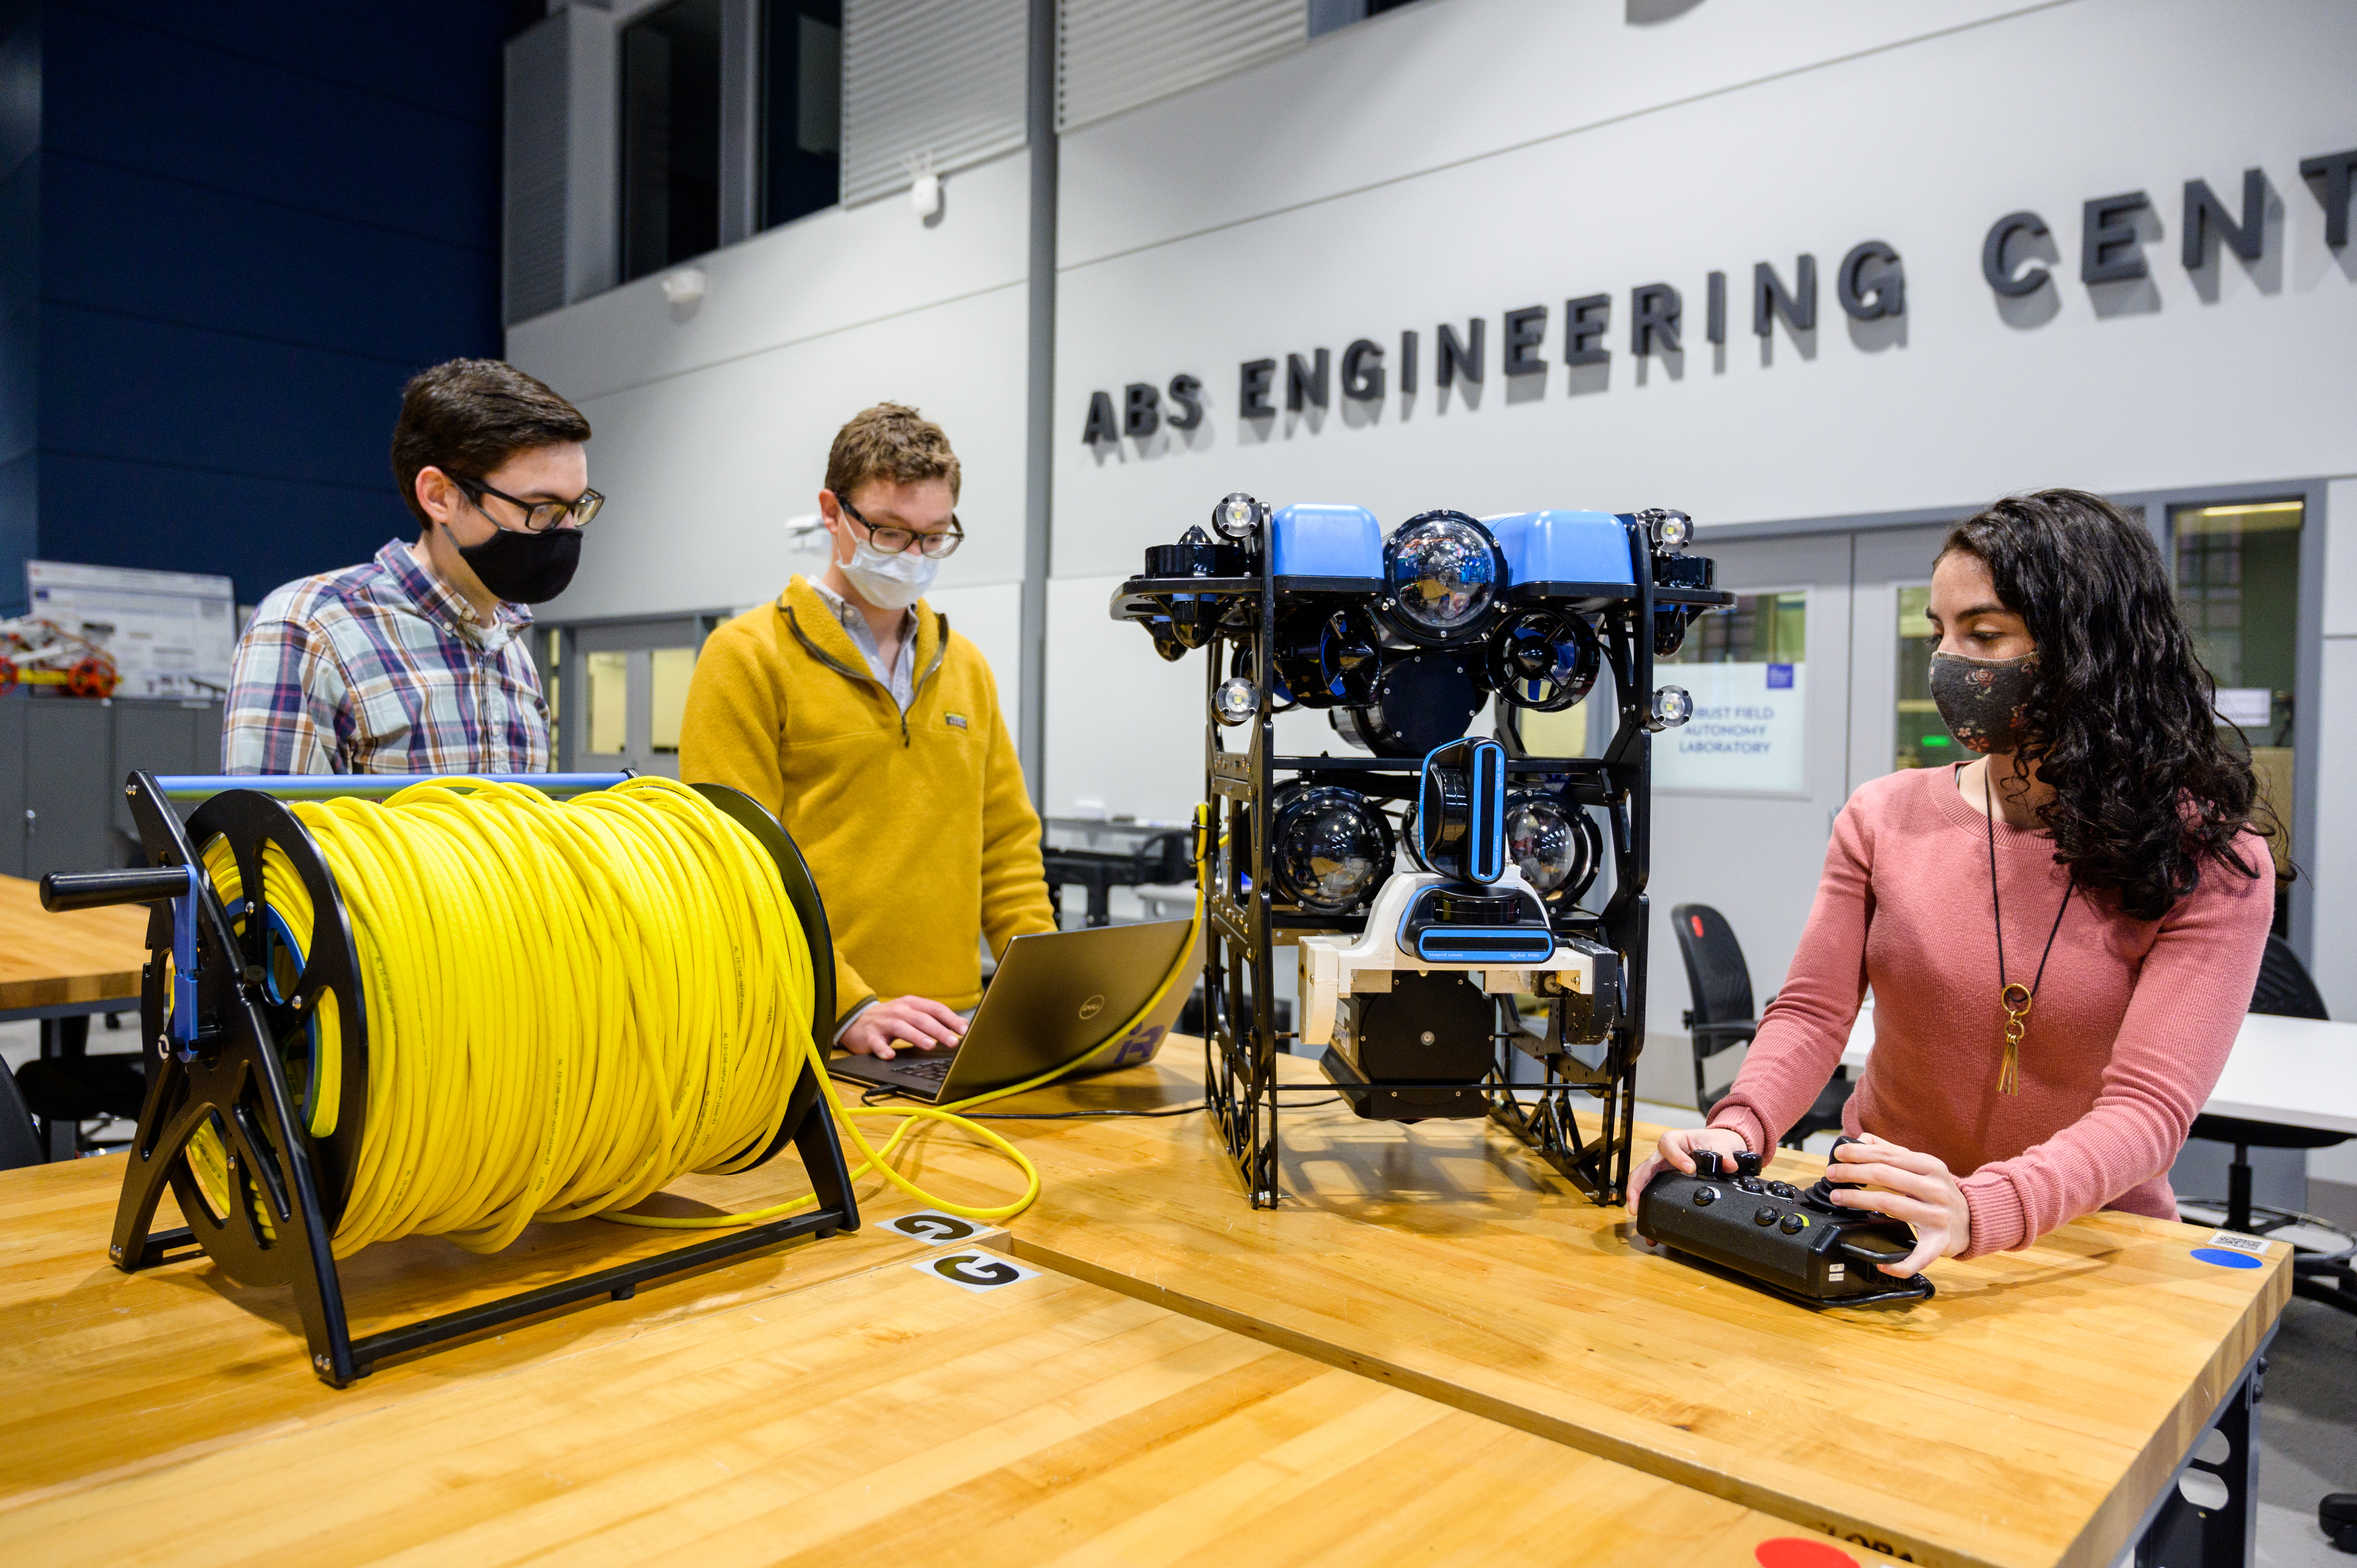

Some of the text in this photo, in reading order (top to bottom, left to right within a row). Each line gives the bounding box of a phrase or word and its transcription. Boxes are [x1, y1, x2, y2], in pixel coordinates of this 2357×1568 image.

[1081, 148, 2357, 445] ABS ENGINEERING CENT
[1691, 706, 1774, 718] OBUST FIELD
[1684, 724, 1765, 737] AUTONOMY
[1679, 740, 1770, 754] LABORATORY
[894, 1215, 974, 1240] G
[933, 1255, 1019, 1285] G
